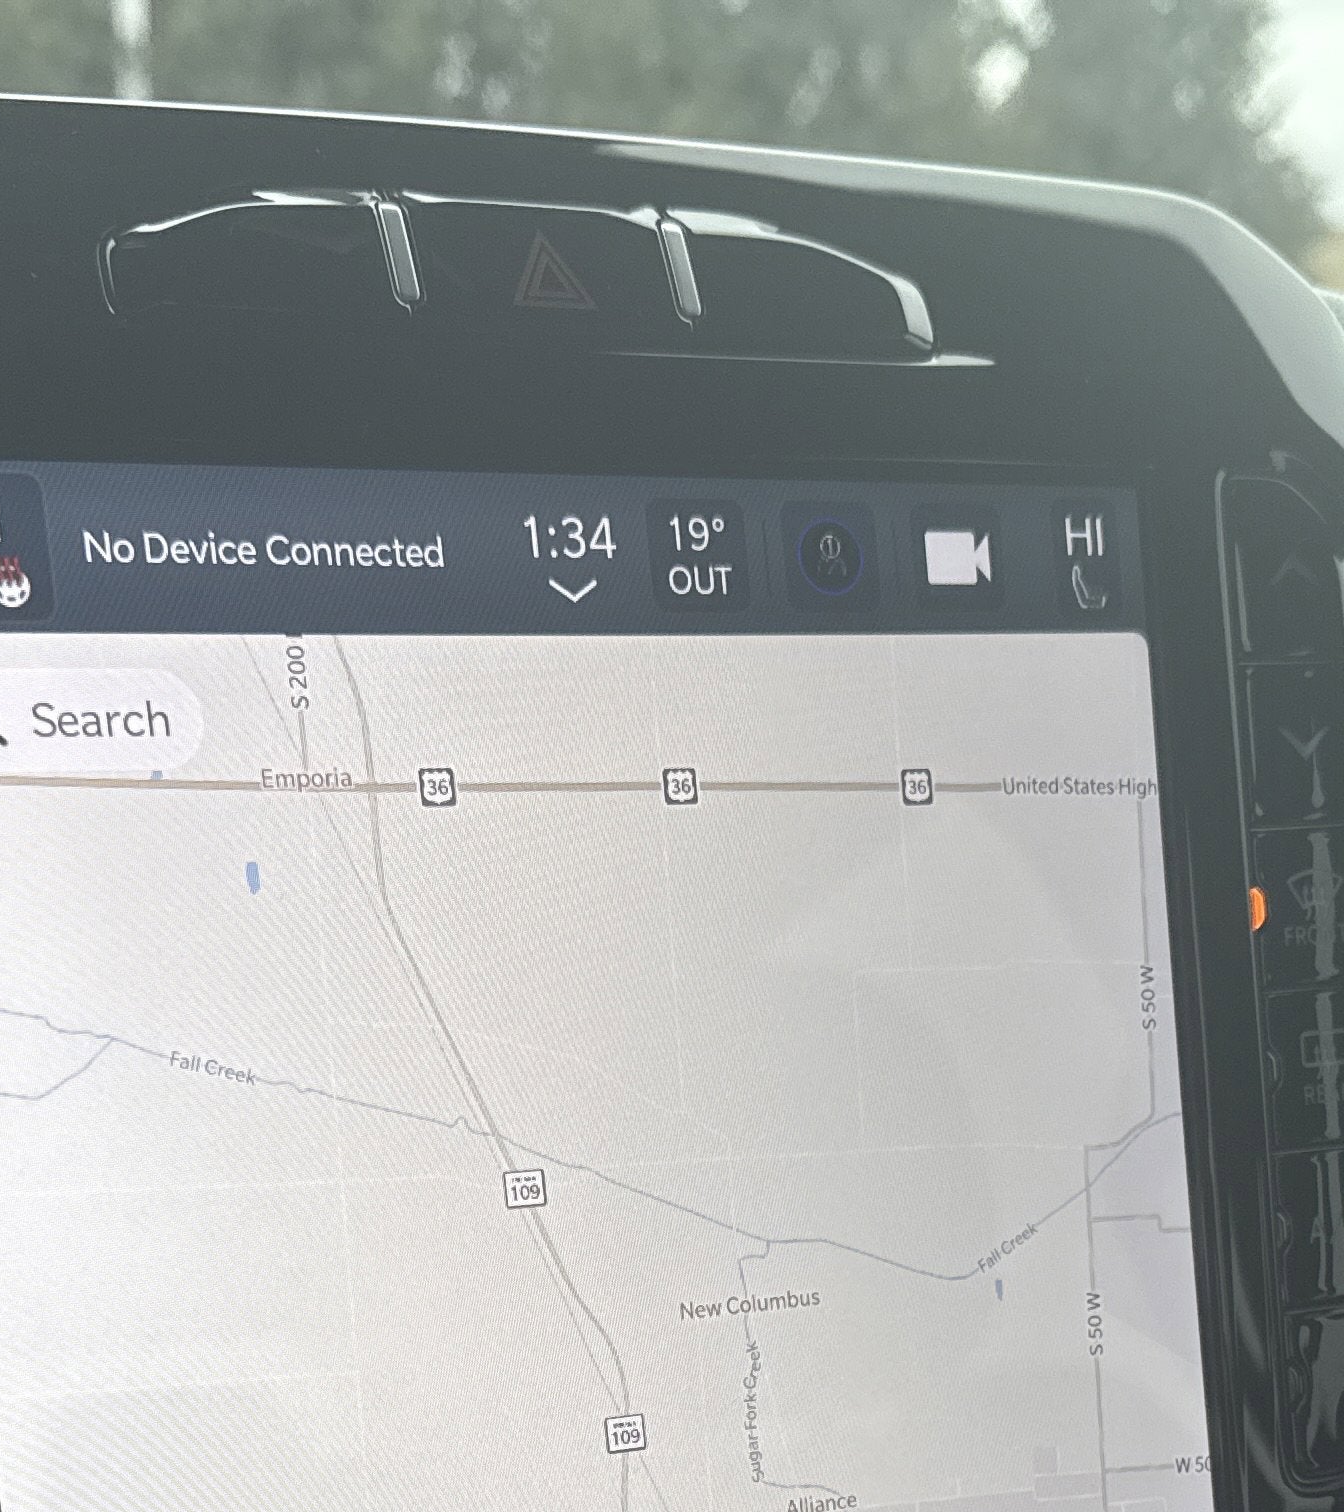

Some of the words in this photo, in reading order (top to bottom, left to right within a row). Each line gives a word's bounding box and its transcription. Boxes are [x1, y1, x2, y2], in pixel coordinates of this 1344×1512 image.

[523, 515, 617, 559] 1:34
[669, 515, 725, 551] 19°
[1064, 515, 1105, 557] HI
[83, 530, 135, 563] No
[144, 533, 258, 566] Device
[266, 533, 445, 568] Connected
[668, 566, 732, 595] OUT
[286, 645, 308, 690] 200
[291, 694, 309, 710] S
[31, 702, 172, 738] Search
[261, 767, 353, 792] Emporia
[427, 778, 449, 797] 36
[671, 778, 691, 796] 36
[908, 778, 927, 796] 36
[1002, 776, 1058, 796] United
[1062, 776, 1115, 796] States
[1140, 965, 1154, 987] W
[1141, 988, 1157, 1013] 50
[1142, 1016, 1157, 1030] S
[169, 1050, 202, 1073] Fall
[205, 1057, 256, 1086] Creek
[511, 1184, 541, 1202] 109
[977, 1248, 1002, 1273] Fall
[1000, 1223, 1038, 1254] Creek
[679, 1300, 721, 1320] New
[726, 1289, 821, 1315] Columbus
[1086, 1292, 1101, 1311] W
[1087, 1315, 1103, 1340] 50
[1089, 1343, 1104, 1356] S
[743, 1340, 761, 1390] Creek
[744, 1390, 758, 1431] Fork
[611, 1427, 641, 1448] 109
[748, 1432, 764, 1483] Sugar
[1175, 1457, 1191, 1475] W
